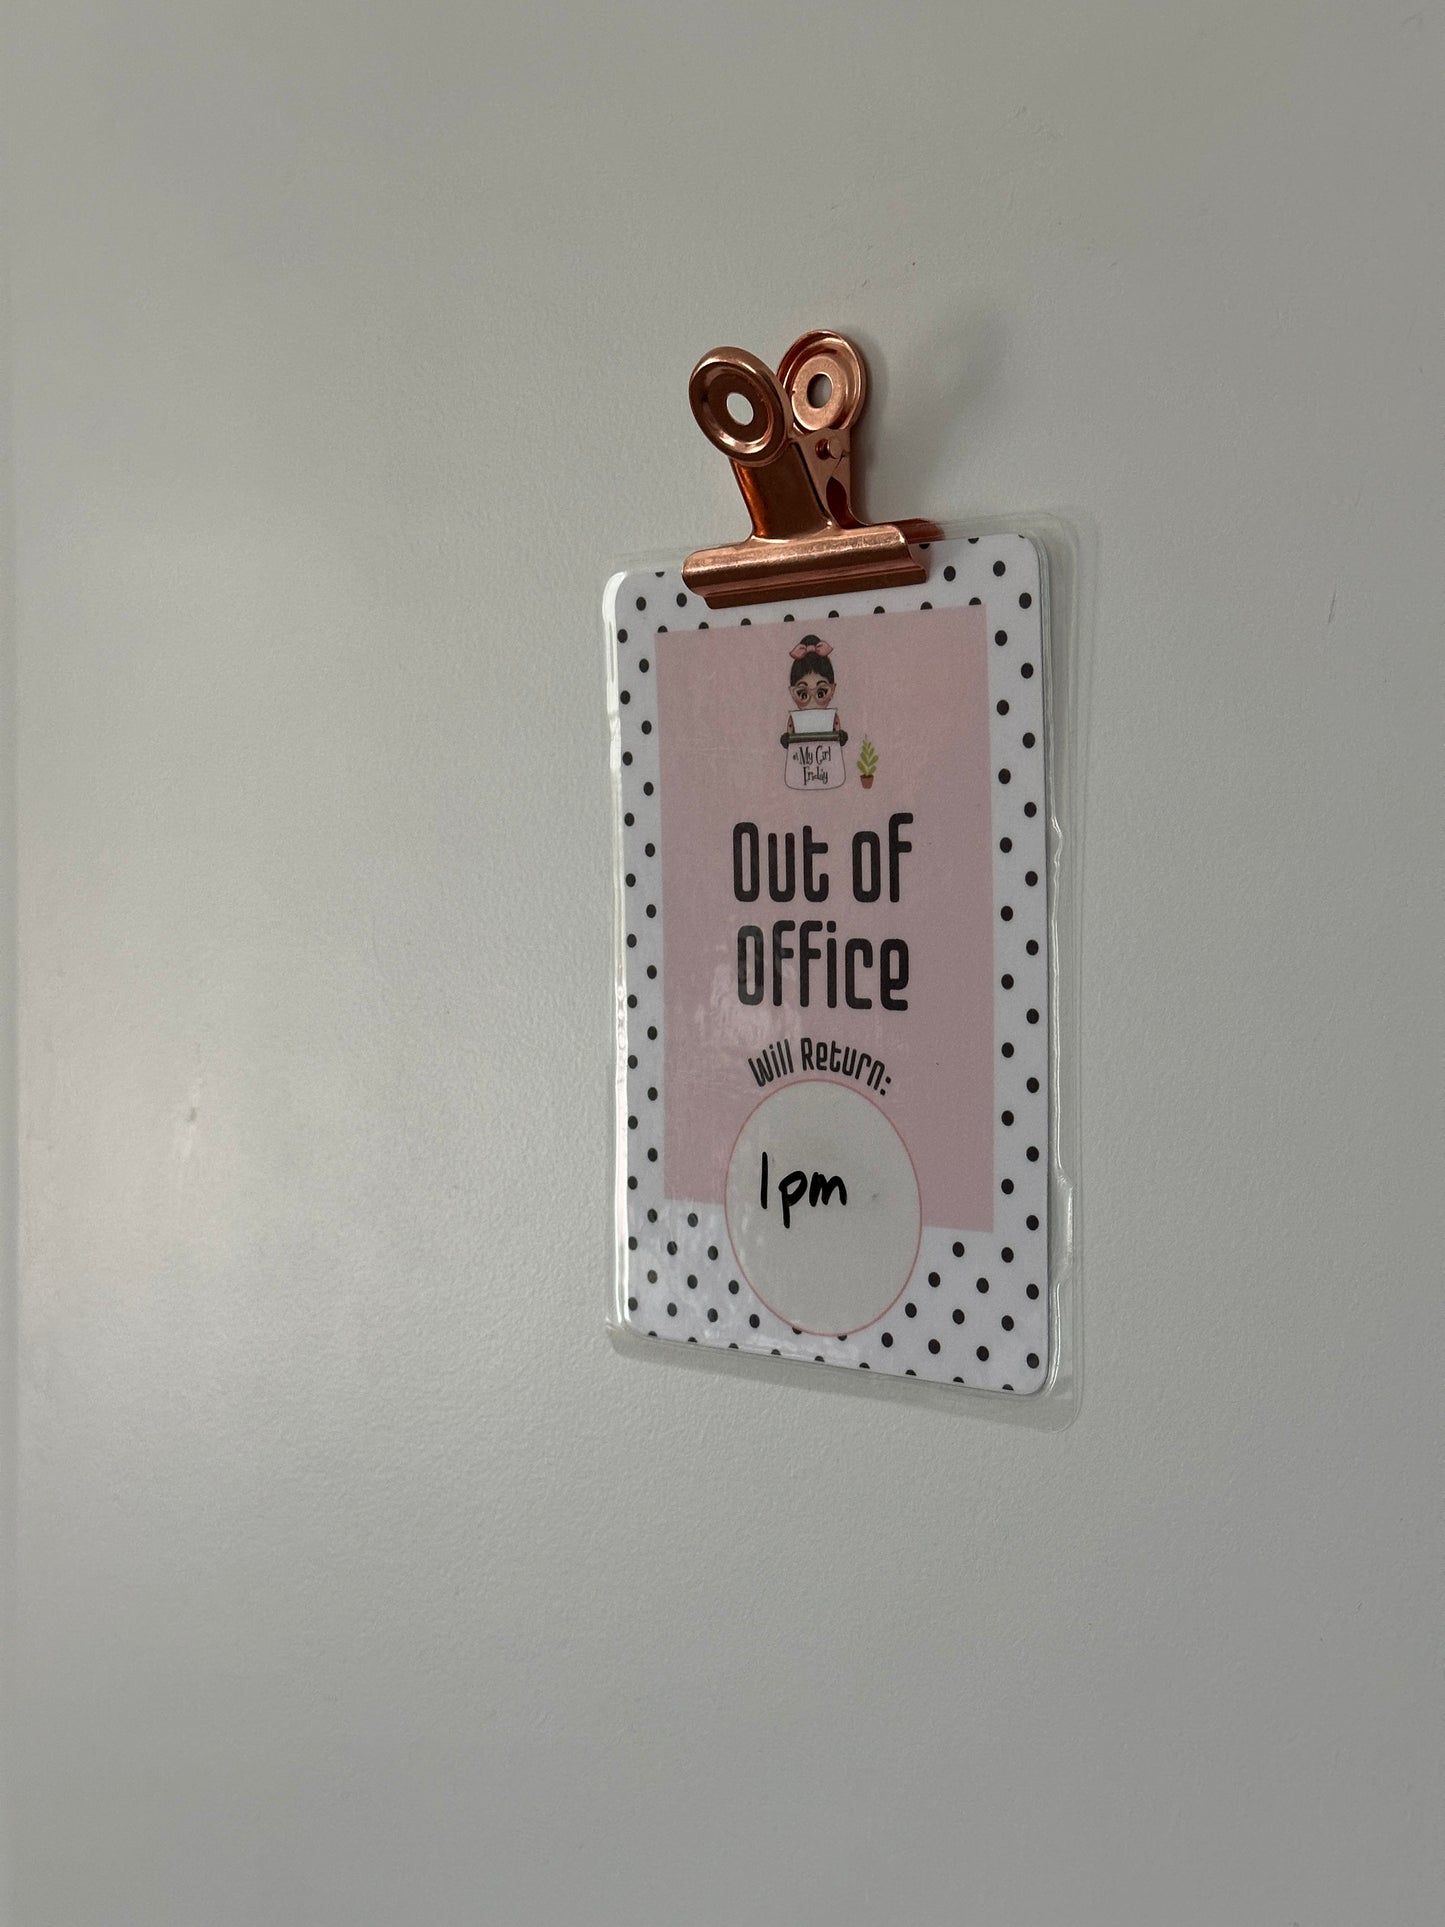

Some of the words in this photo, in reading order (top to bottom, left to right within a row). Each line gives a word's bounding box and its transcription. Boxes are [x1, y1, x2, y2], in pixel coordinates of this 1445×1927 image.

[803, 766, 828, 785] Friday
[734, 822, 829, 902] Out
[852, 813, 914, 903] of
[737, 920, 909, 1011] Office
[748, 1038, 794, 1087] Will
[800, 1037, 891, 1096] Return:
